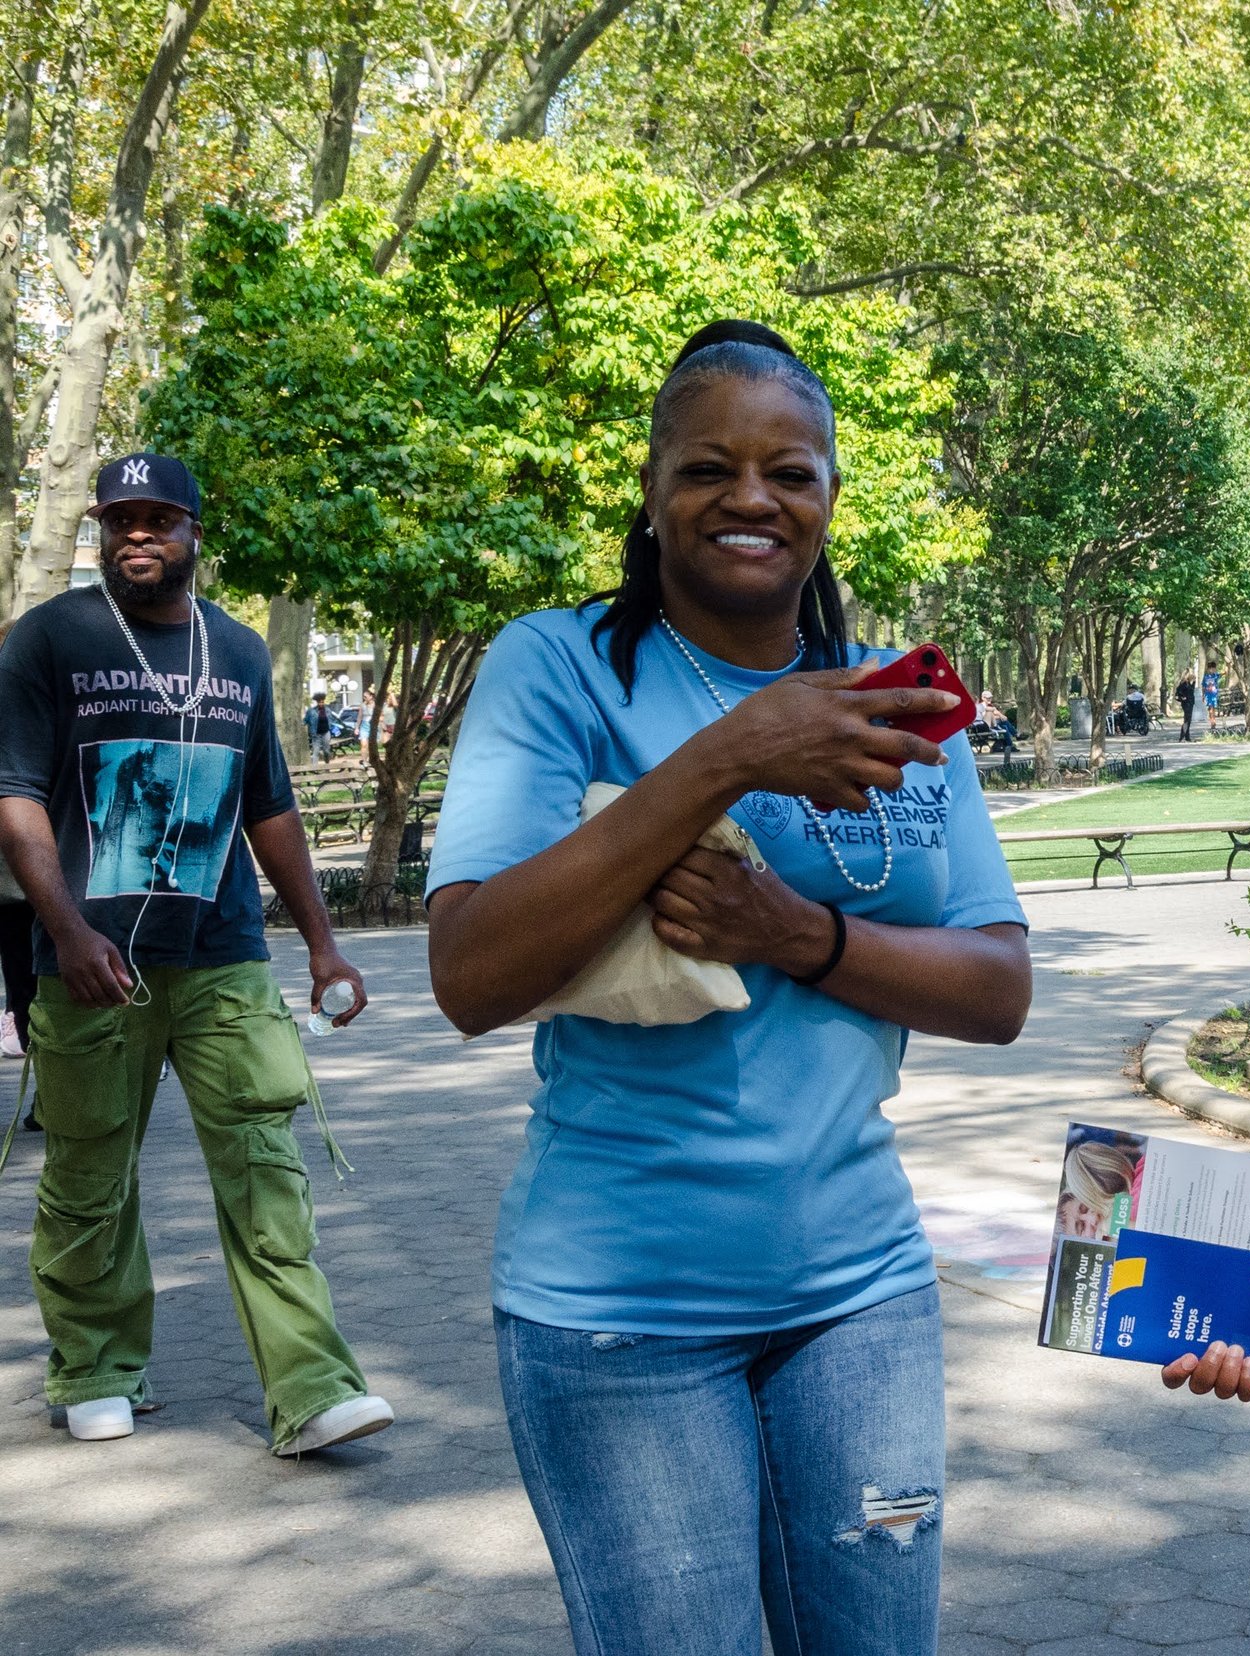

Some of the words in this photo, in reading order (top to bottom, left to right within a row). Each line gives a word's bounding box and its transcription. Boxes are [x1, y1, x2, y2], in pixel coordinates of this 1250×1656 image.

[121, 459, 150, 485] NY
[71, 670, 189, 695] RADIANT
[194, 676, 252, 707] AURA
[77, 698, 138, 717] RADIANT
[180, 703, 206, 718] LL
[803, 823, 893, 847] RKERS
[1114, 1197, 1130, 1225] Loss
[1075, 1254, 1089, 1280] Your
[1095, 1253, 1104, 1262] a
[1089, 1262, 1103, 1290] After
[1066, 1282, 1088, 1347] Supporting
[1086, 1291, 1099, 1314] One
[1167, 1295, 1185, 1339] Suicide
[1184, 1308, 1199, 1341] stops
[1196, 1313, 1213, 1343] here.
[1080, 1316, 1096, 1348] Loved
